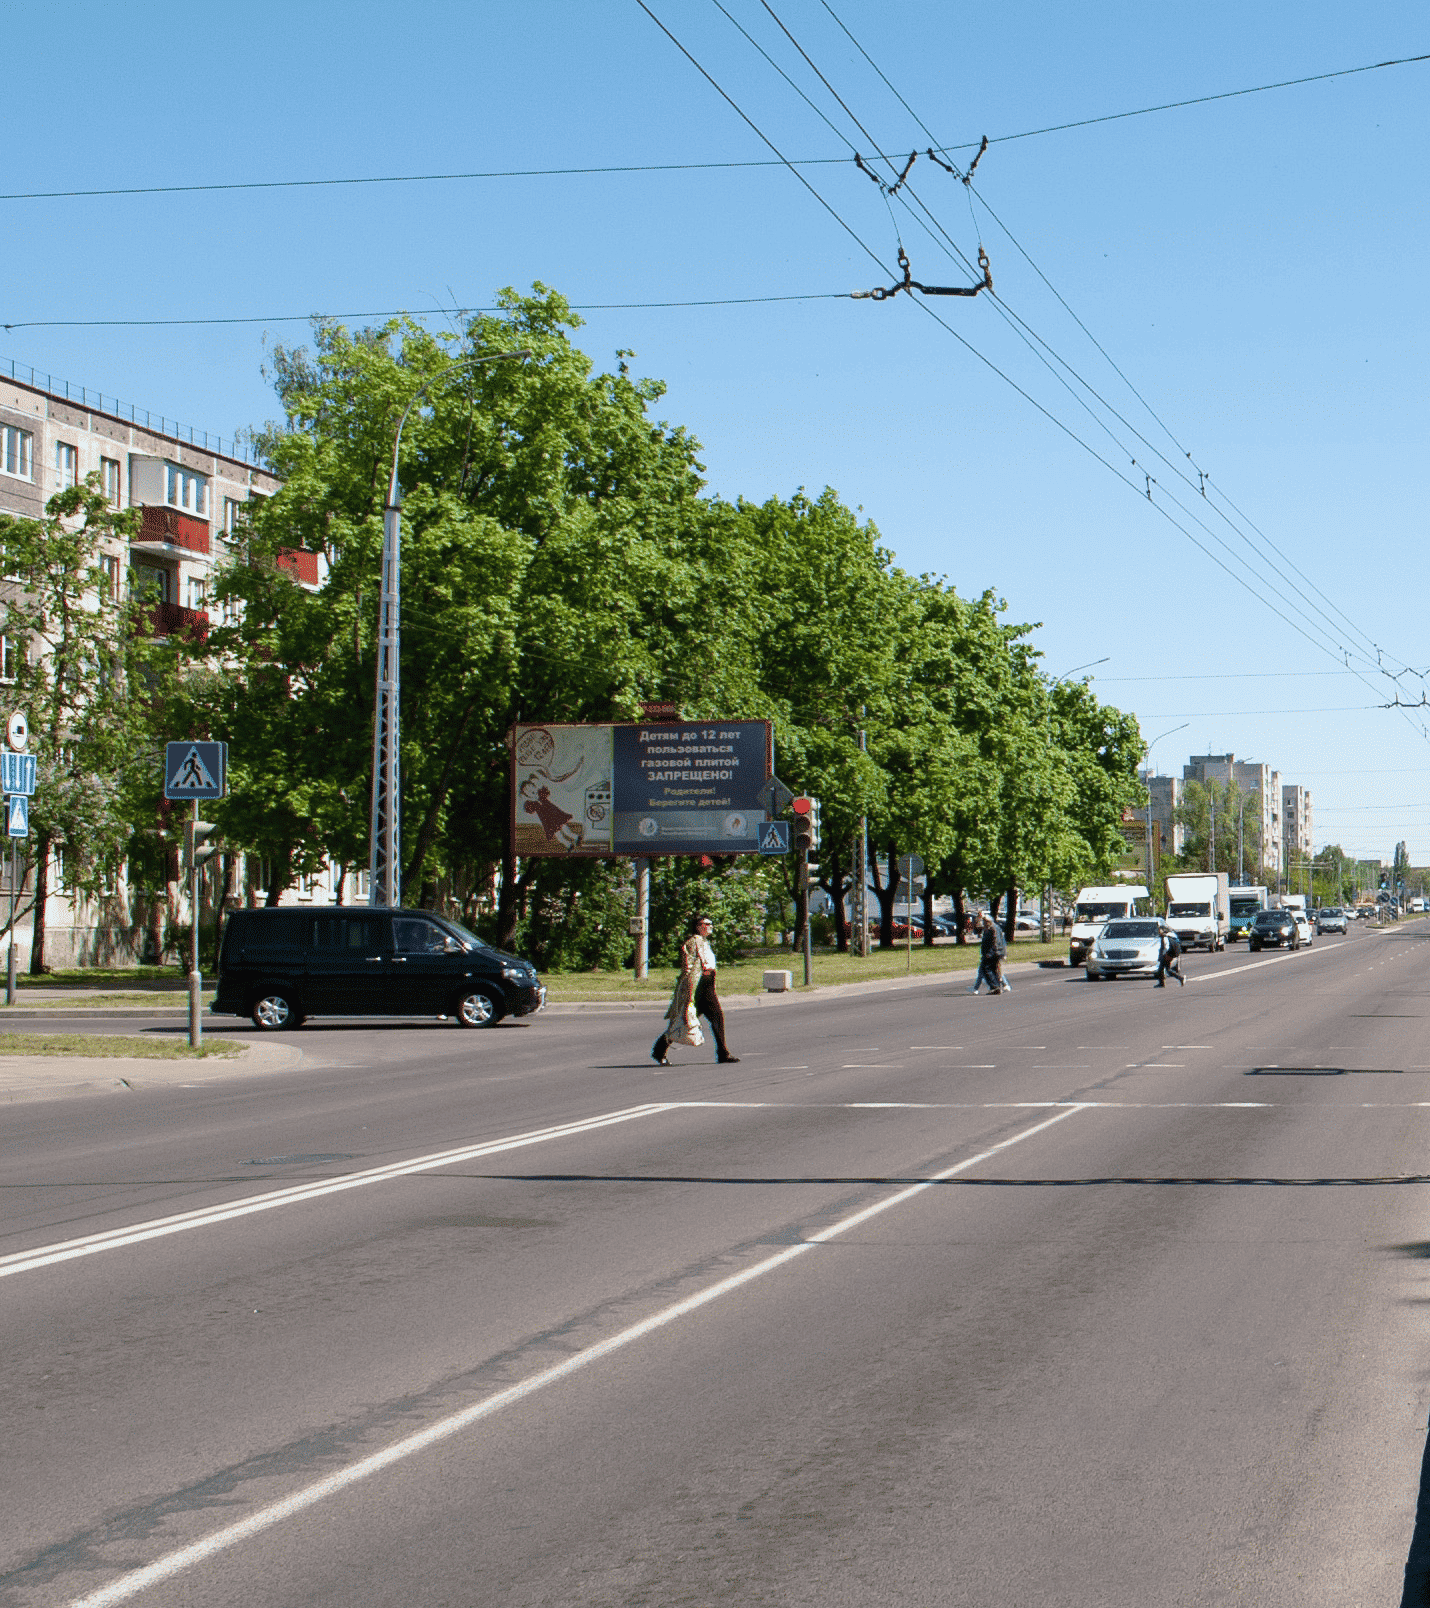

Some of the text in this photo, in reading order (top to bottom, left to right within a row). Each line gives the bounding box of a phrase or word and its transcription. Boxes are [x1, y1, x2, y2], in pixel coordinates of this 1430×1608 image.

[640, 730, 741, 742] Детям до 12 лет
[647, 745, 733, 754] пользоваться
[641, 757, 740, 768] газовой плитой
[648, 770, 733, 781] ЗАПРЕЩЕНО!
